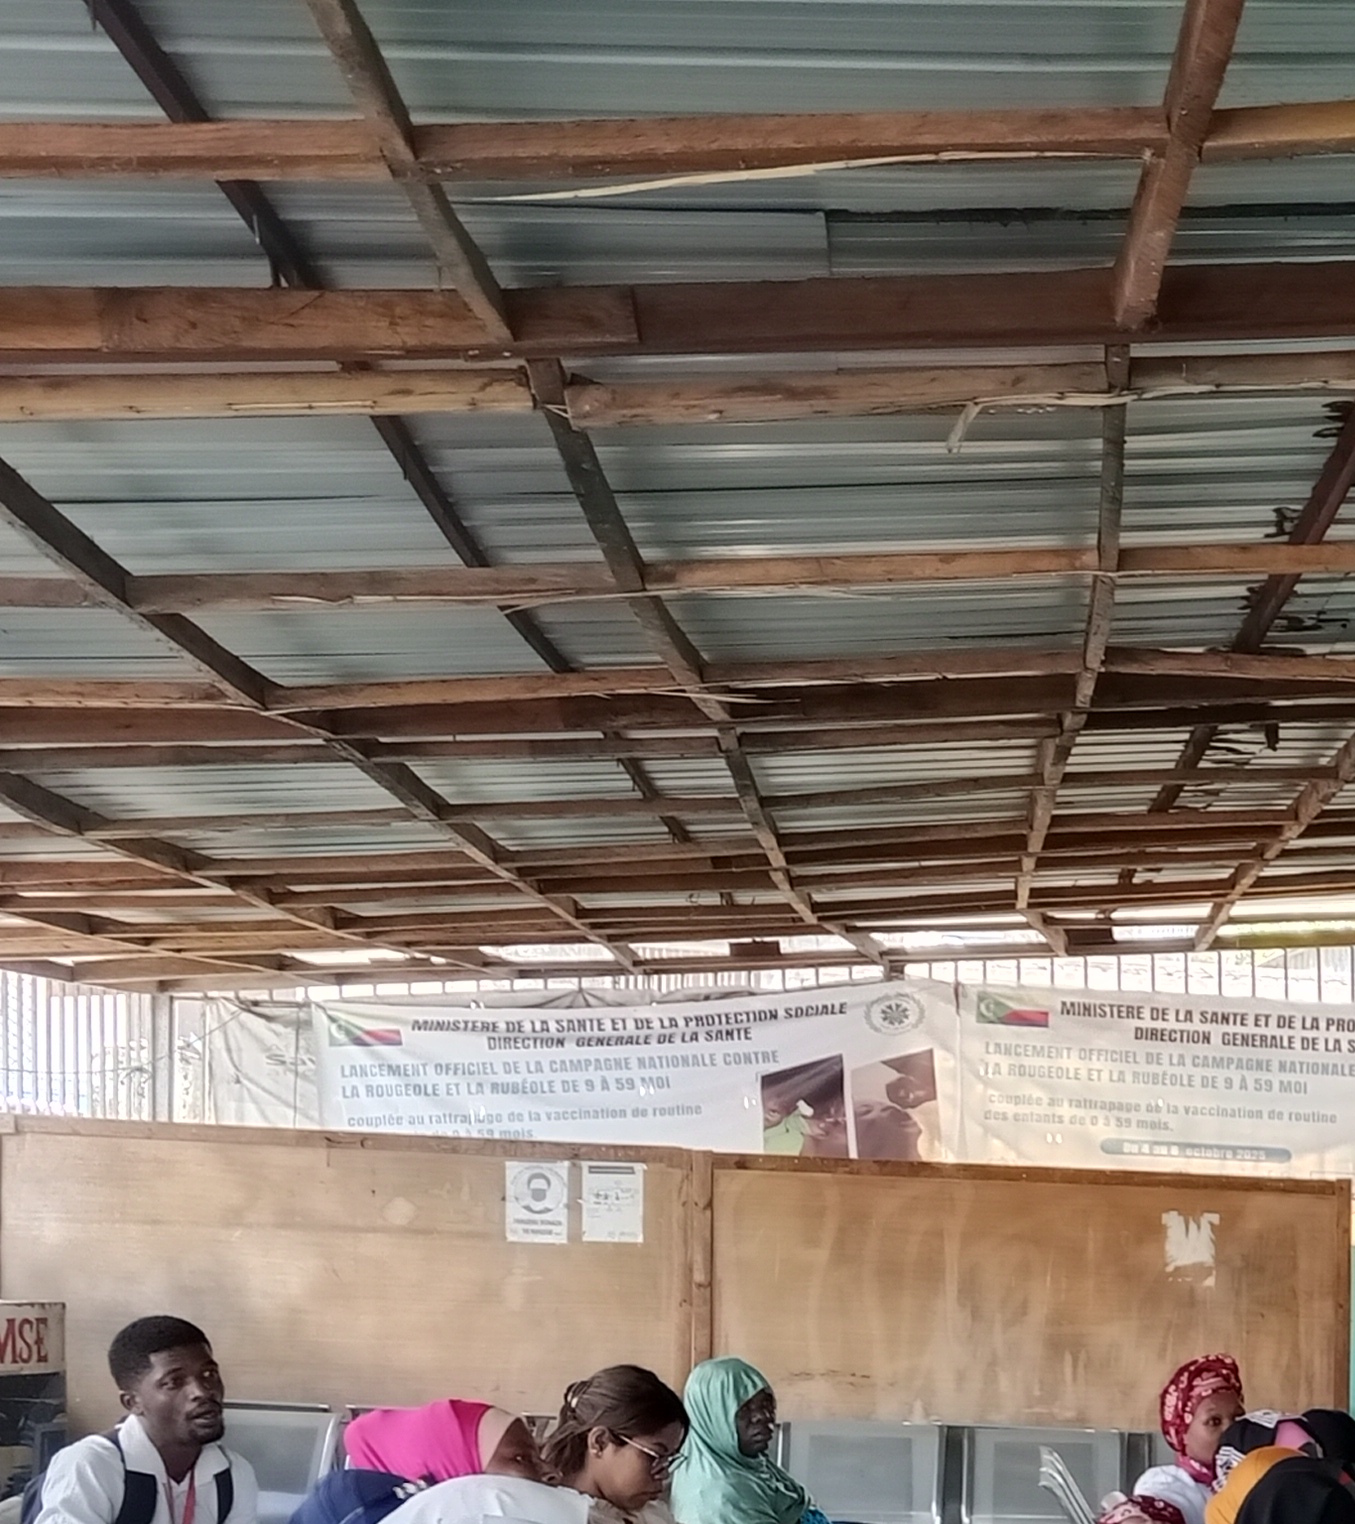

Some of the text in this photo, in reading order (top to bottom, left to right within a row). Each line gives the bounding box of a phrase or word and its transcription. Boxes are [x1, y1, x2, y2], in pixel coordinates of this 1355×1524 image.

[411, 1002, 848, 1033] MINISTERE DE LA SANTE ET DE LA PROTECTION SOCIALE
[1060, 1000, 1146, 1020] MINISTERE
[1149, 1006, 1170, 1021] DE
[1174, 1008, 1194, 1023] LA
[1199, 1010, 1249, 1026] SANTE
[1253, 1013, 1272, 1027] ET
[1276, 1014, 1297, 1029] DE
[1301, 1016, 1320, 1031] LA
[487, 1026, 752, 1050] DIRECTION GENERALE DE LA SANTE
[1133, 1026, 1212, 1045] DIRECTION
[1221, 1031, 1296, 1050] GENERALE
[1300, 1037, 1320, 1051] DE
[1324, 1037, 1343, 1053] LA
[340, 1049, 780, 1079] LANCEMENT OFFICIEL DE LA CAMPAGNE NATIONALE CONTRE
[342, 1084, 359, 1099] LA
[365, 1083, 440, 1098] ROUGEOLE
[446, 1082, 461, 1096] ET
[467, 1081, 485, 1095] LA
[490, 1075, 556, 1095] RUBÉOLE
[561, 1079, 580, 1093] DE
[584, 1079, 595, 1093] 9
[600, 1075, 611, 1091] À
[614, 1077, 635, 1091] 59
